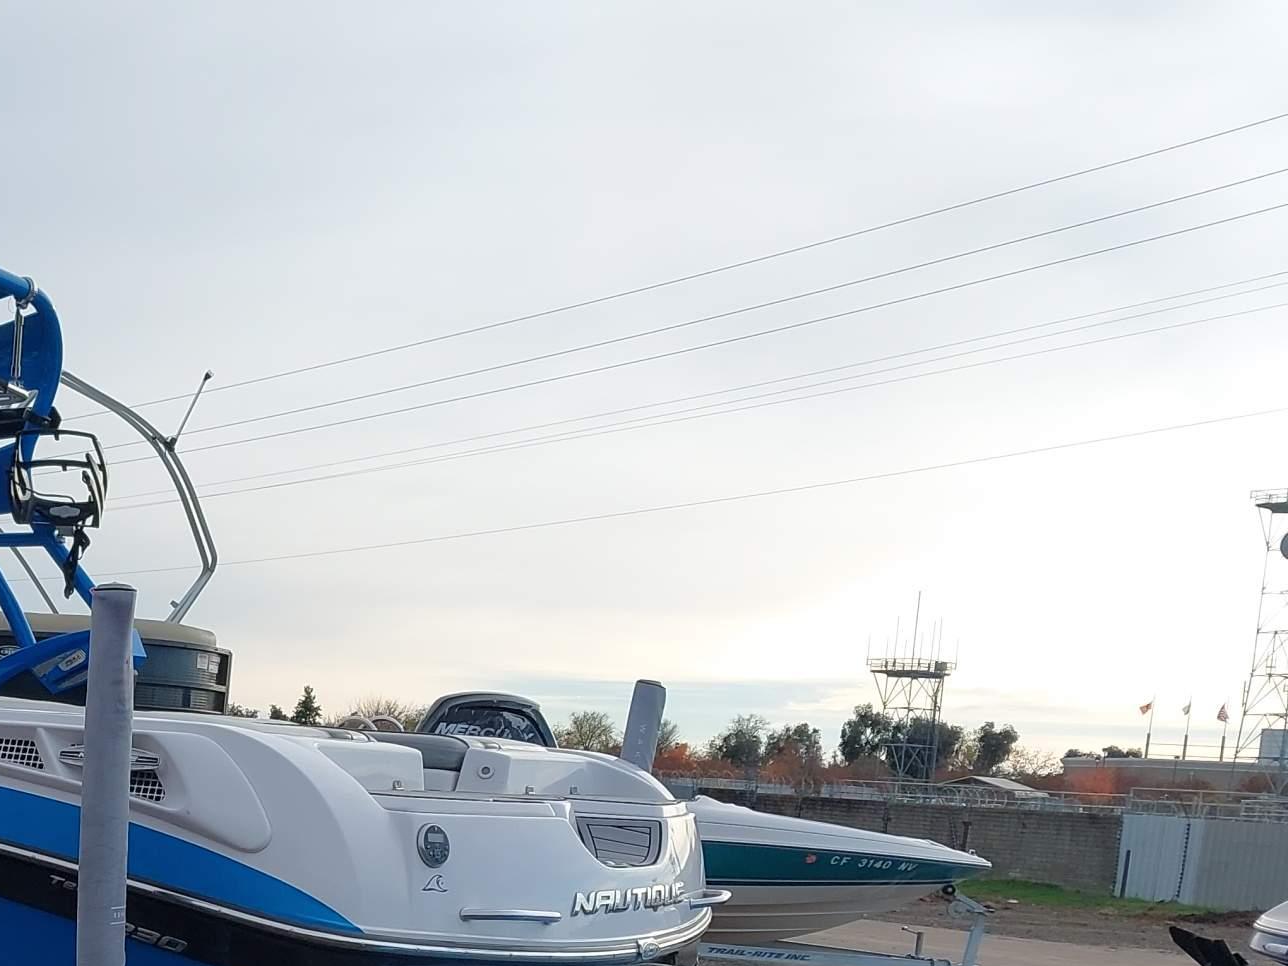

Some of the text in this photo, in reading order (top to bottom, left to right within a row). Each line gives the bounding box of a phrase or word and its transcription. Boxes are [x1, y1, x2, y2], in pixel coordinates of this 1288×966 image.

[830, 855, 919, 872] CF 3140 NV
[571, 882, 686, 917] NAUTIQUE
[707, 946, 786, 959] TRAIL-RITE
